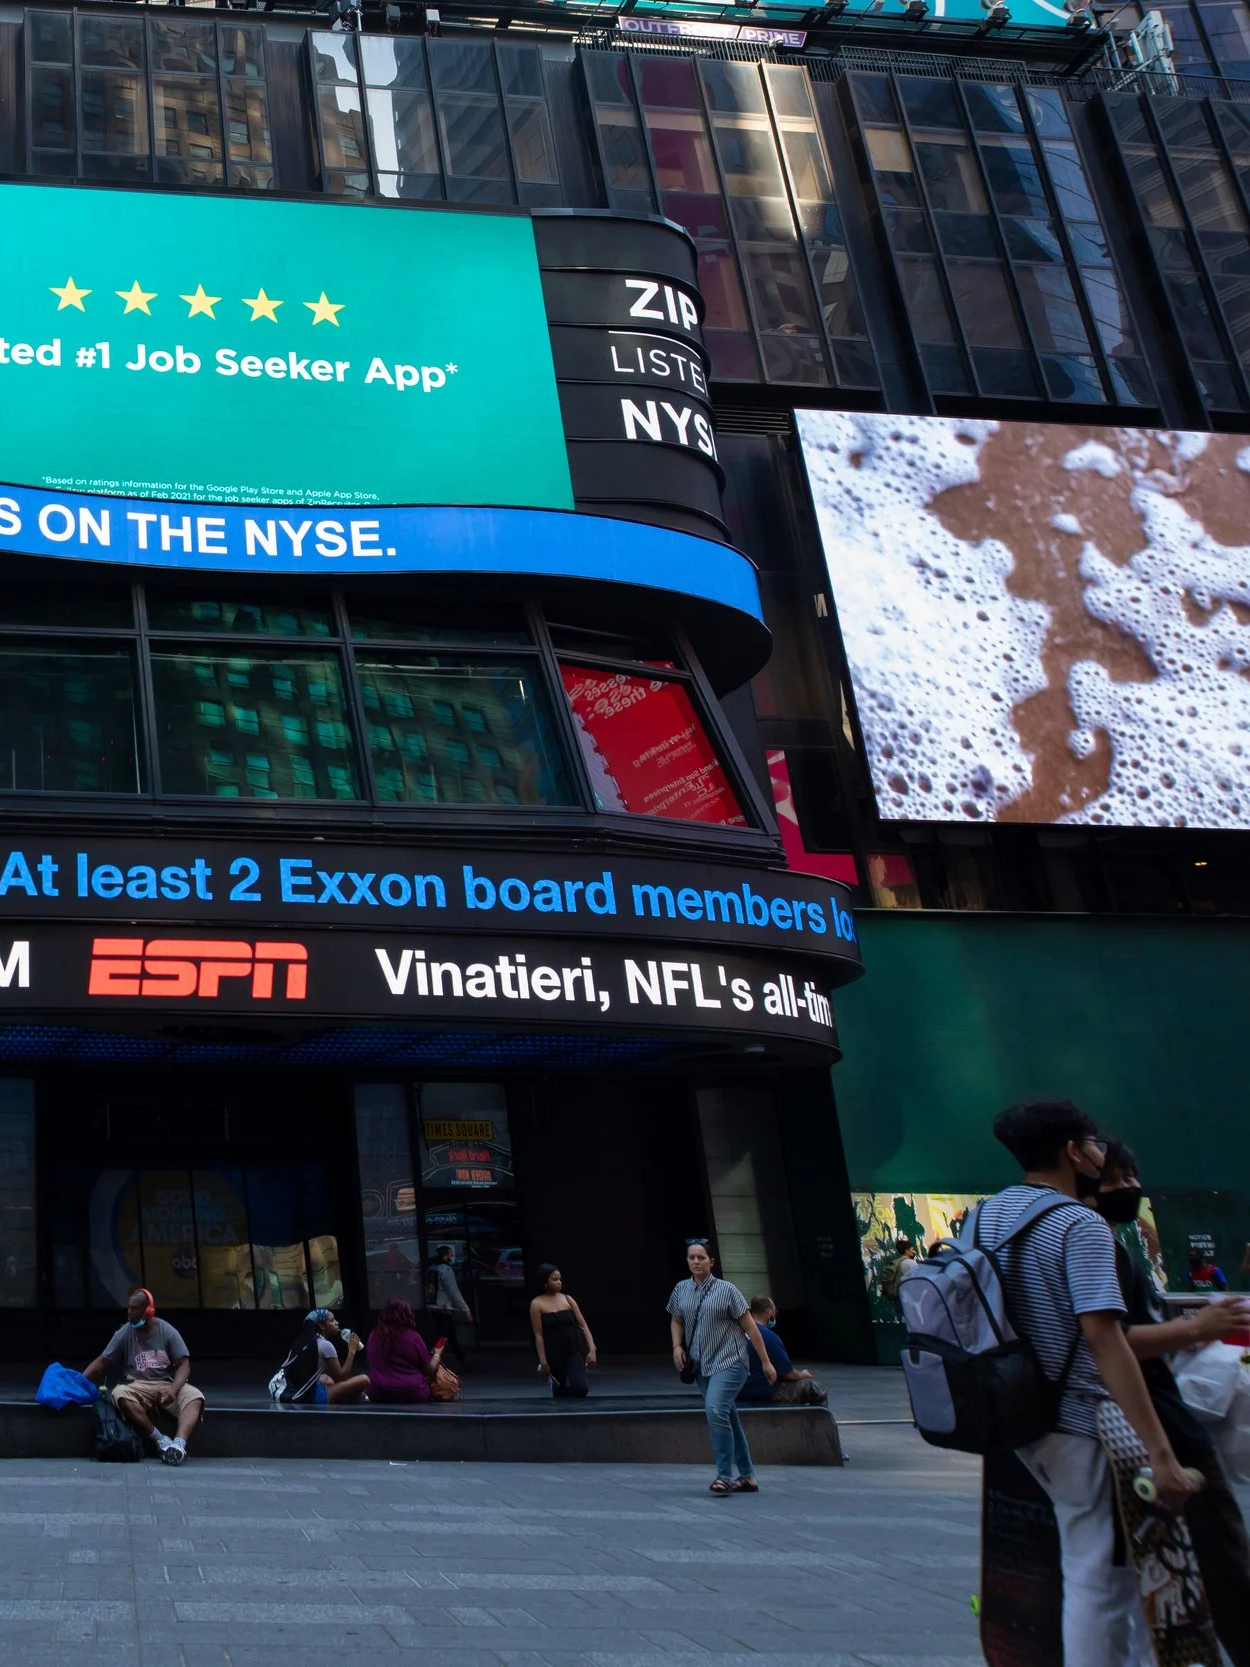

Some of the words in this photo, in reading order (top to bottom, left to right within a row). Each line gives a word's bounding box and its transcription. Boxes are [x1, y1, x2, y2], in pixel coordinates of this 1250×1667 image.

[746, 29, 800, 45] PRIME
[625, 279, 698, 331] ZIP
[75, 341, 110, 369] #1
[126, 344, 201, 376] Job
[216, 349, 350, 383] Seeker
[611, 346, 708, 397] LISTE
[621, 399, 718, 464] NYS
[75, 478, 87, 486] on
[89, 478, 120, 488] ratings
[122, 480, 172, 490] information
[174, 482, 188, 491] for
[190, 483, 204, 491] the
[206, 484, 238, 493] Google
[240, 485, 259, 495] Play
[261, 486, 284, 495] Store
[287, 488, 303, 496] and
[305, 489, 331, 499] Apple
[334, 490, 352, 499] App
[140, 490, 150, 498] of
[151, 491, 168, 500] Feb
[170, 492, 191, 500] 2021
[193, 493, 207, 501] for
[208, 494, 222, 502] the
[224, 494, 239, 504] job
[241, 495, 270, 504] seeker
[272, 497, 294, 506] apps
[38, 504, 111, 547] ON
[127, 512, 228, 555] THE
[245, 518, 397, 557] NYSE.
[77, 853, 213, 900] least
[229, 857, 262, 902] 2
[280, 858, 447, 908] Exxon
[463, 865, 616, 916] board
[632, 882, 827, 934] members
[88, 938, 308, 999] ESPN
[374, 948, 610, 1012] Vinatieri,
[624, 958, 754, 1012] NFL's
[426, 1122, 453, 1137] TIMES
[455, 1122, 491, 1137] SQUARE
